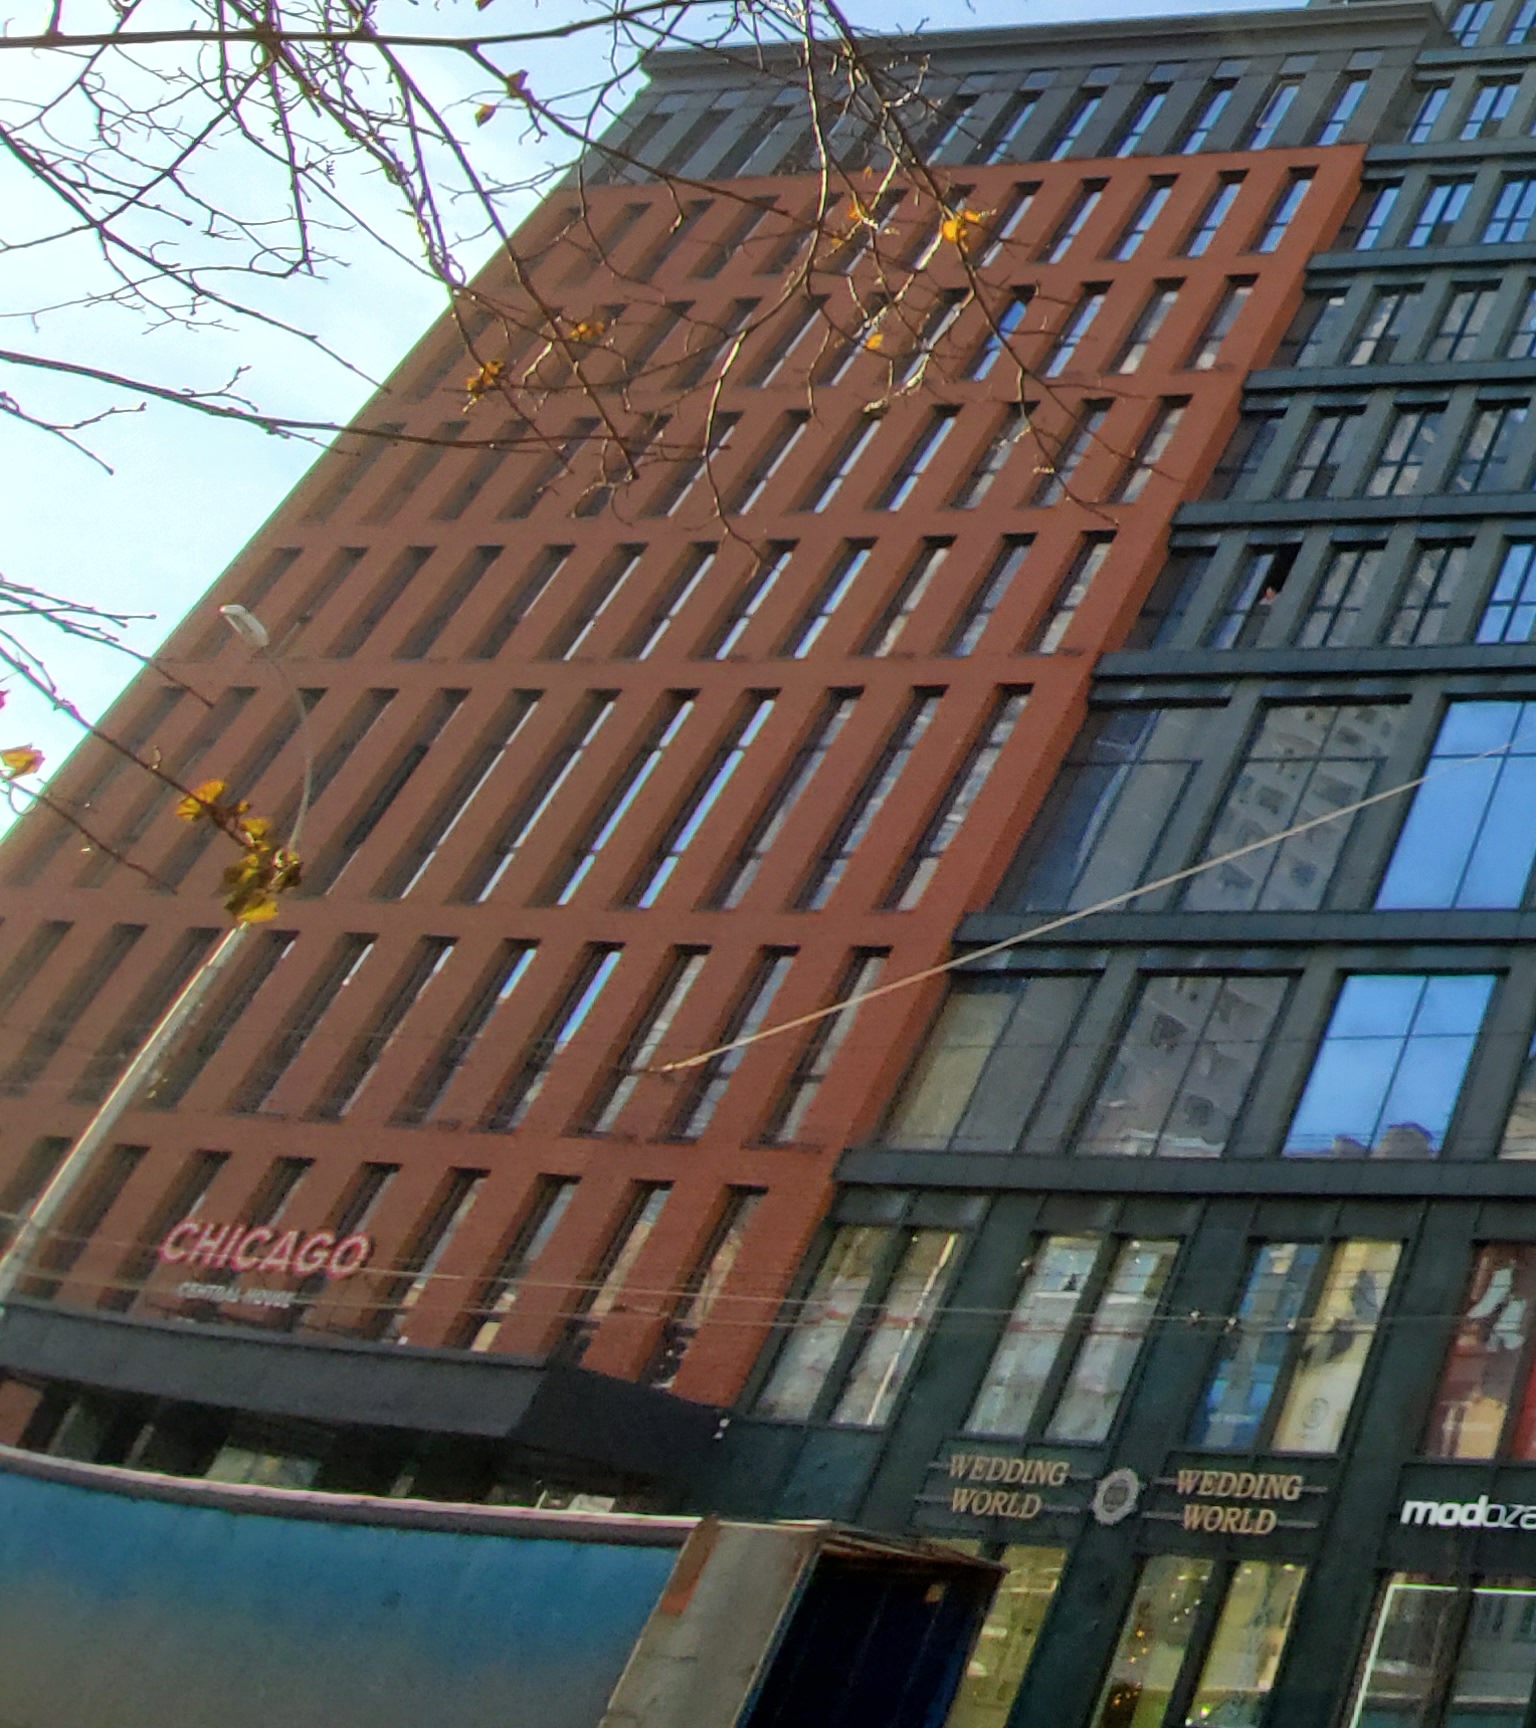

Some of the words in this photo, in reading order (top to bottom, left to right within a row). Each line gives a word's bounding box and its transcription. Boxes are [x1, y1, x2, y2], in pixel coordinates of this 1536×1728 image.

[157, 1219, 371, 1280] CHICAGO
[950, 1454, 1071, 1486] WEDDING
[1177, 1470, 1303, 1501] WEDDING
[952, 1487, 1042, 1519] WORLD
[1182, 1504, 1276, 1535] WORLD
